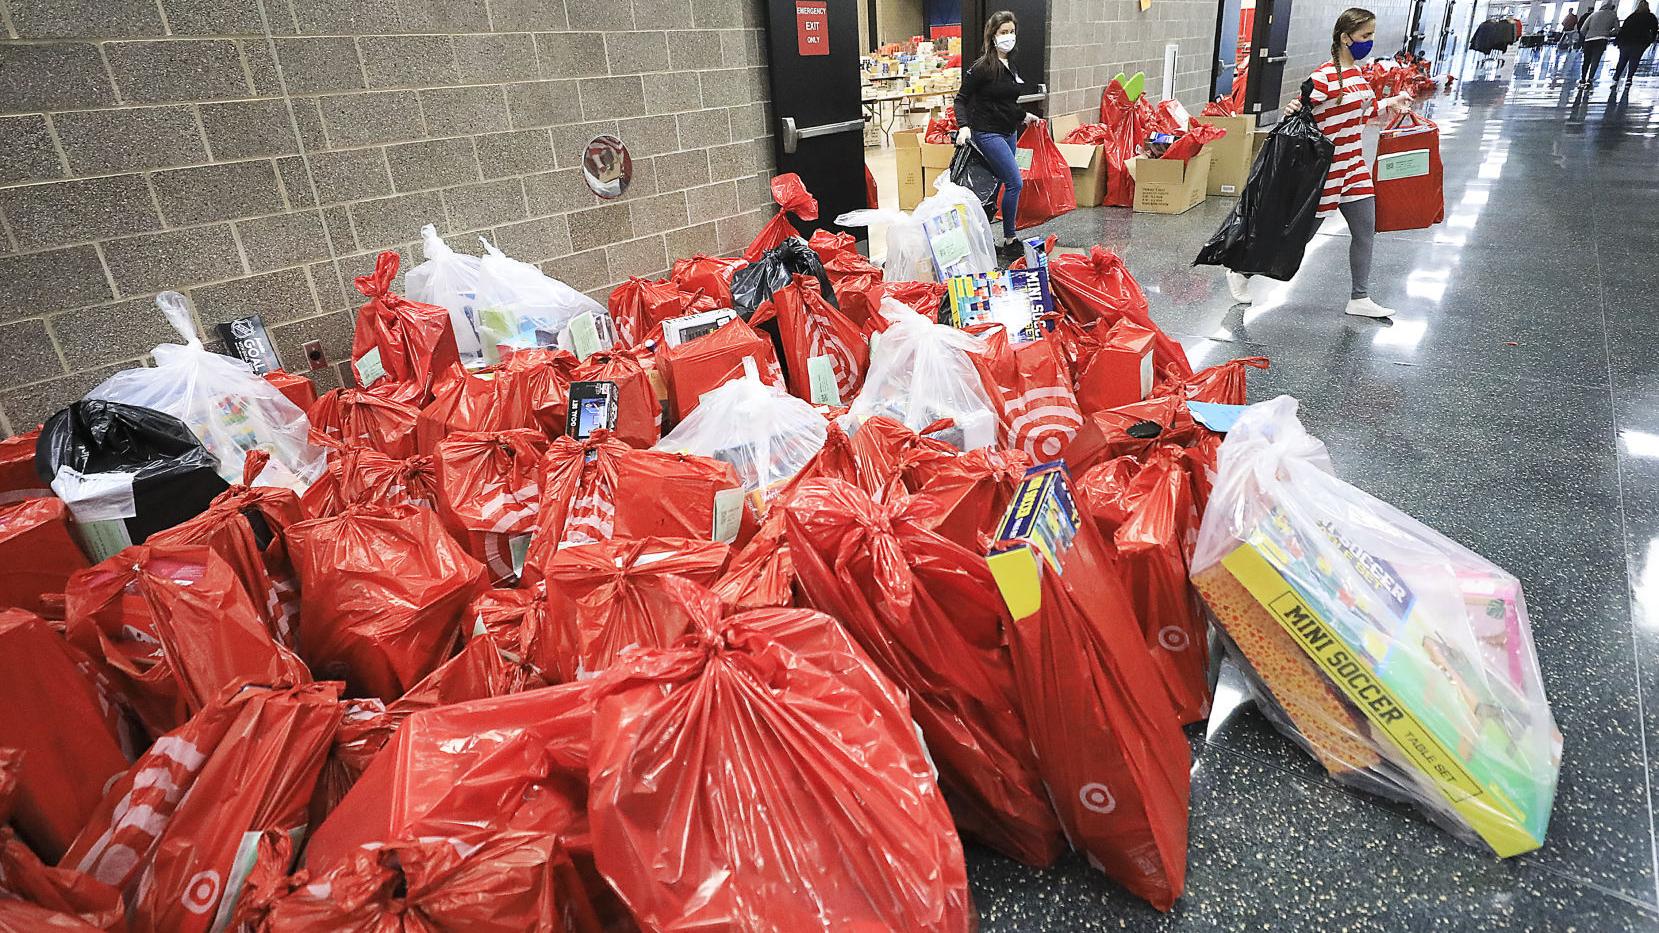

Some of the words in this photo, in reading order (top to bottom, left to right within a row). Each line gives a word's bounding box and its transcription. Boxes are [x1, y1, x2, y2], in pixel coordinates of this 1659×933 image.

[796, 7, 827, 15] EMERGENCY
[805, 21, 820, 31] EXIT
[807, 36, 820, 44] ONLY
[1025, 271, 1043, 301] MINI
[243, 339, 266, 372] GOAL
[570, 411, 578, 427] GOAL
[1284, 605, 1335, 652] MINI
[1327, 651, 1405, 725] SOCCER
[1403, 731, 1437, 764] TABLE
[1434, 763, 1458, 784] SET
